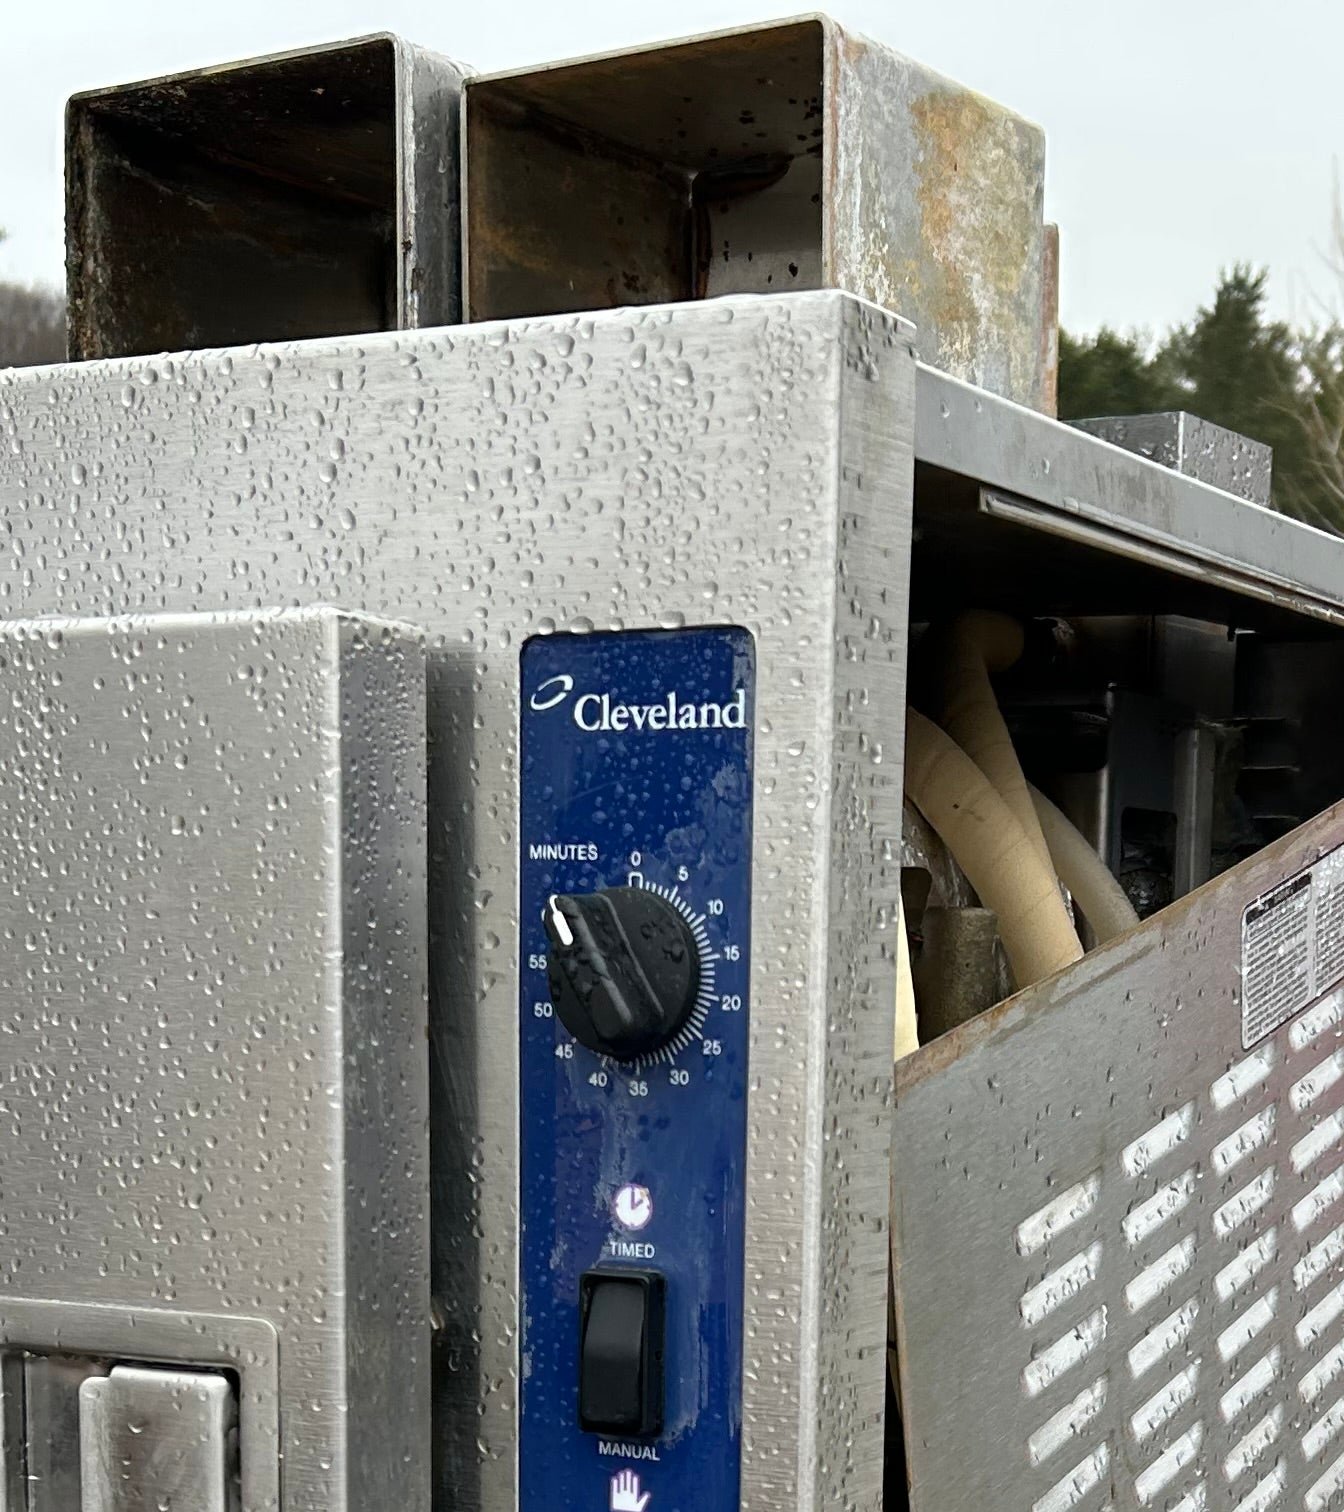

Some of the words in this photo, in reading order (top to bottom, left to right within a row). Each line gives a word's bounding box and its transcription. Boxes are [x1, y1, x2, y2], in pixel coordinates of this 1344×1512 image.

[573, 690, 748, 732] Cleveland
[529, 843, 598, 862] MINUTES
[630, 851, 642, 867] 0
[678, 866, 689, 883] 5
[708, 900, 724, 917] 10
[724, 946, 741, 962] 15
[529, 955, 547, 970] 55
[534, 1003, 553, 1018] 50
[722, 996, 742, 1012] 20
[555, 1044, 574, 1060] 45
[703, 1039, 722, 1056] 25
[588, 1072, 608, 1088] 40
[669, 1070, 690, 1086] 30
[629, 1081, 648, 1098] 35
[609, 1241, 655, 1259] TIMED
[598, 1440, 661, 1463] MANUAL
